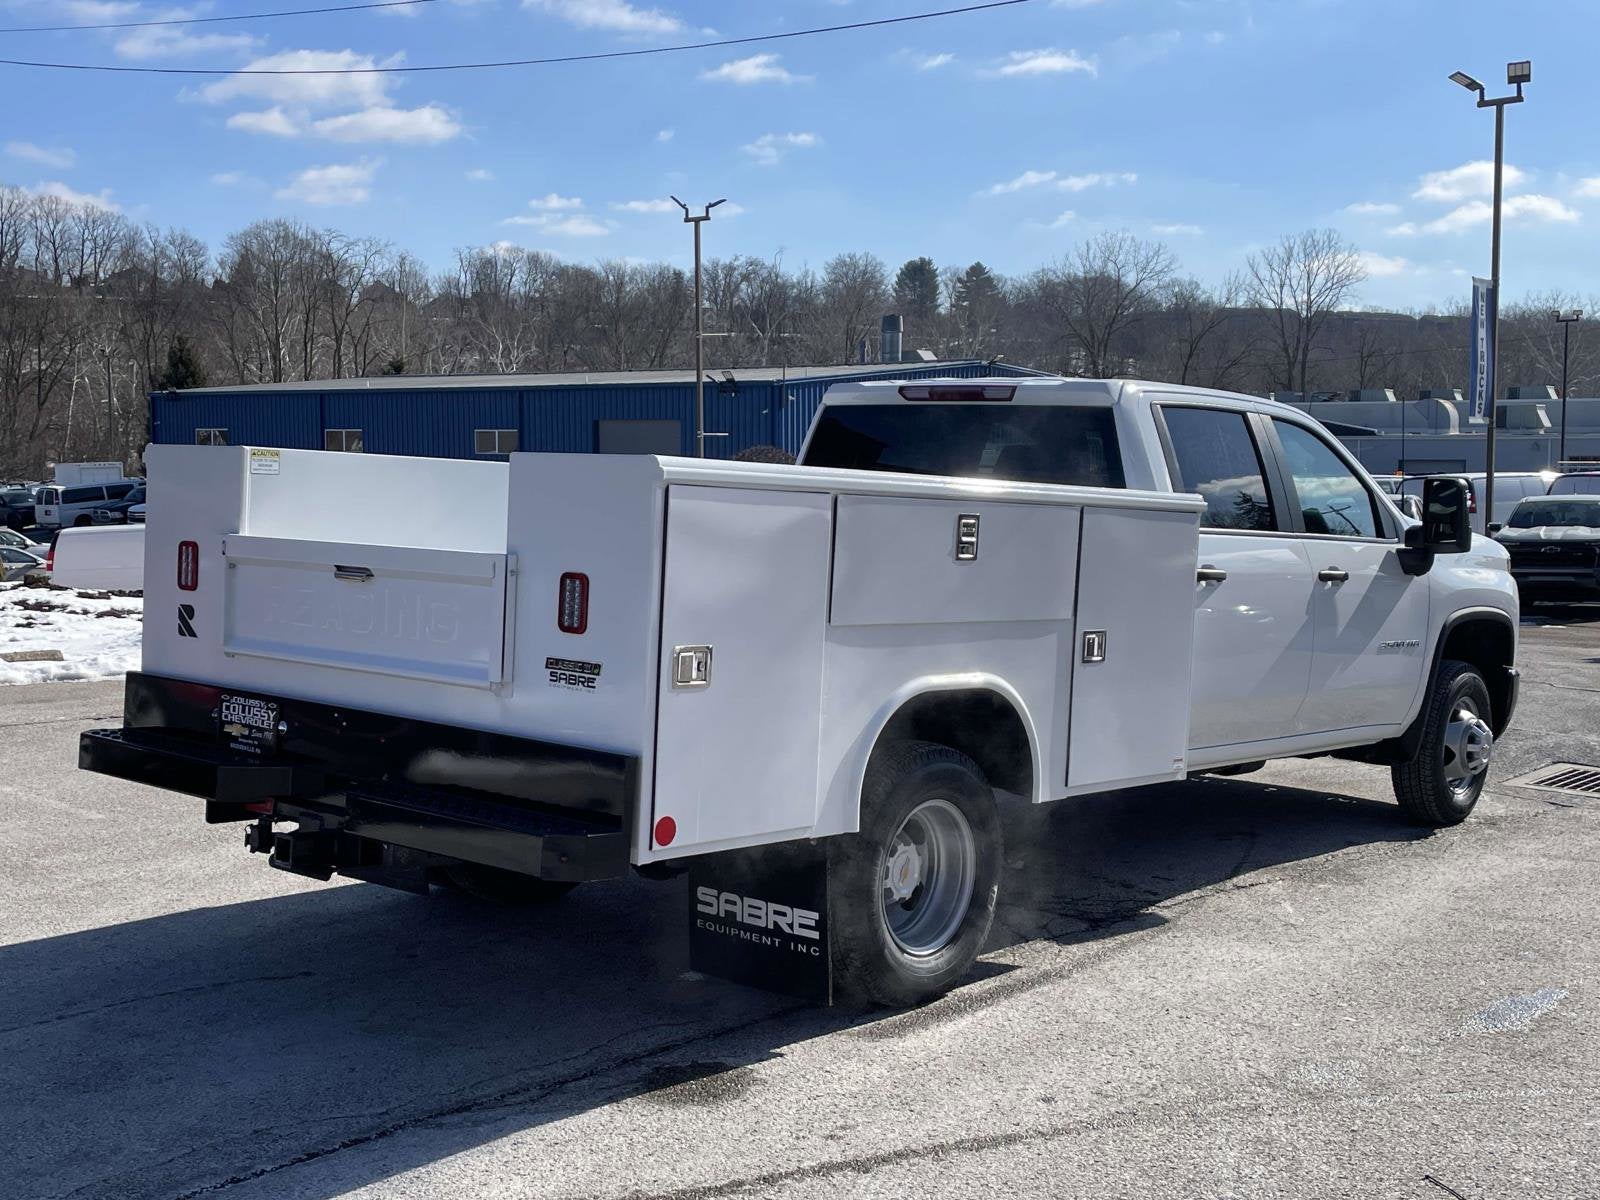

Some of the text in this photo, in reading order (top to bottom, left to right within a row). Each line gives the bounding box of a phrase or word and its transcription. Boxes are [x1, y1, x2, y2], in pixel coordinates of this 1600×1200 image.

[1477, 337, 1485, 414] TRUCKS
[549, 670, 597, 689] SABRE
[221, 712, 274, 729] CHEVROLET
[222, 702, 276, 721] COLUSSY
[697, 886, 820, 940] SABRE
[697, 919, 820, 956] EQUIPMENT INC
